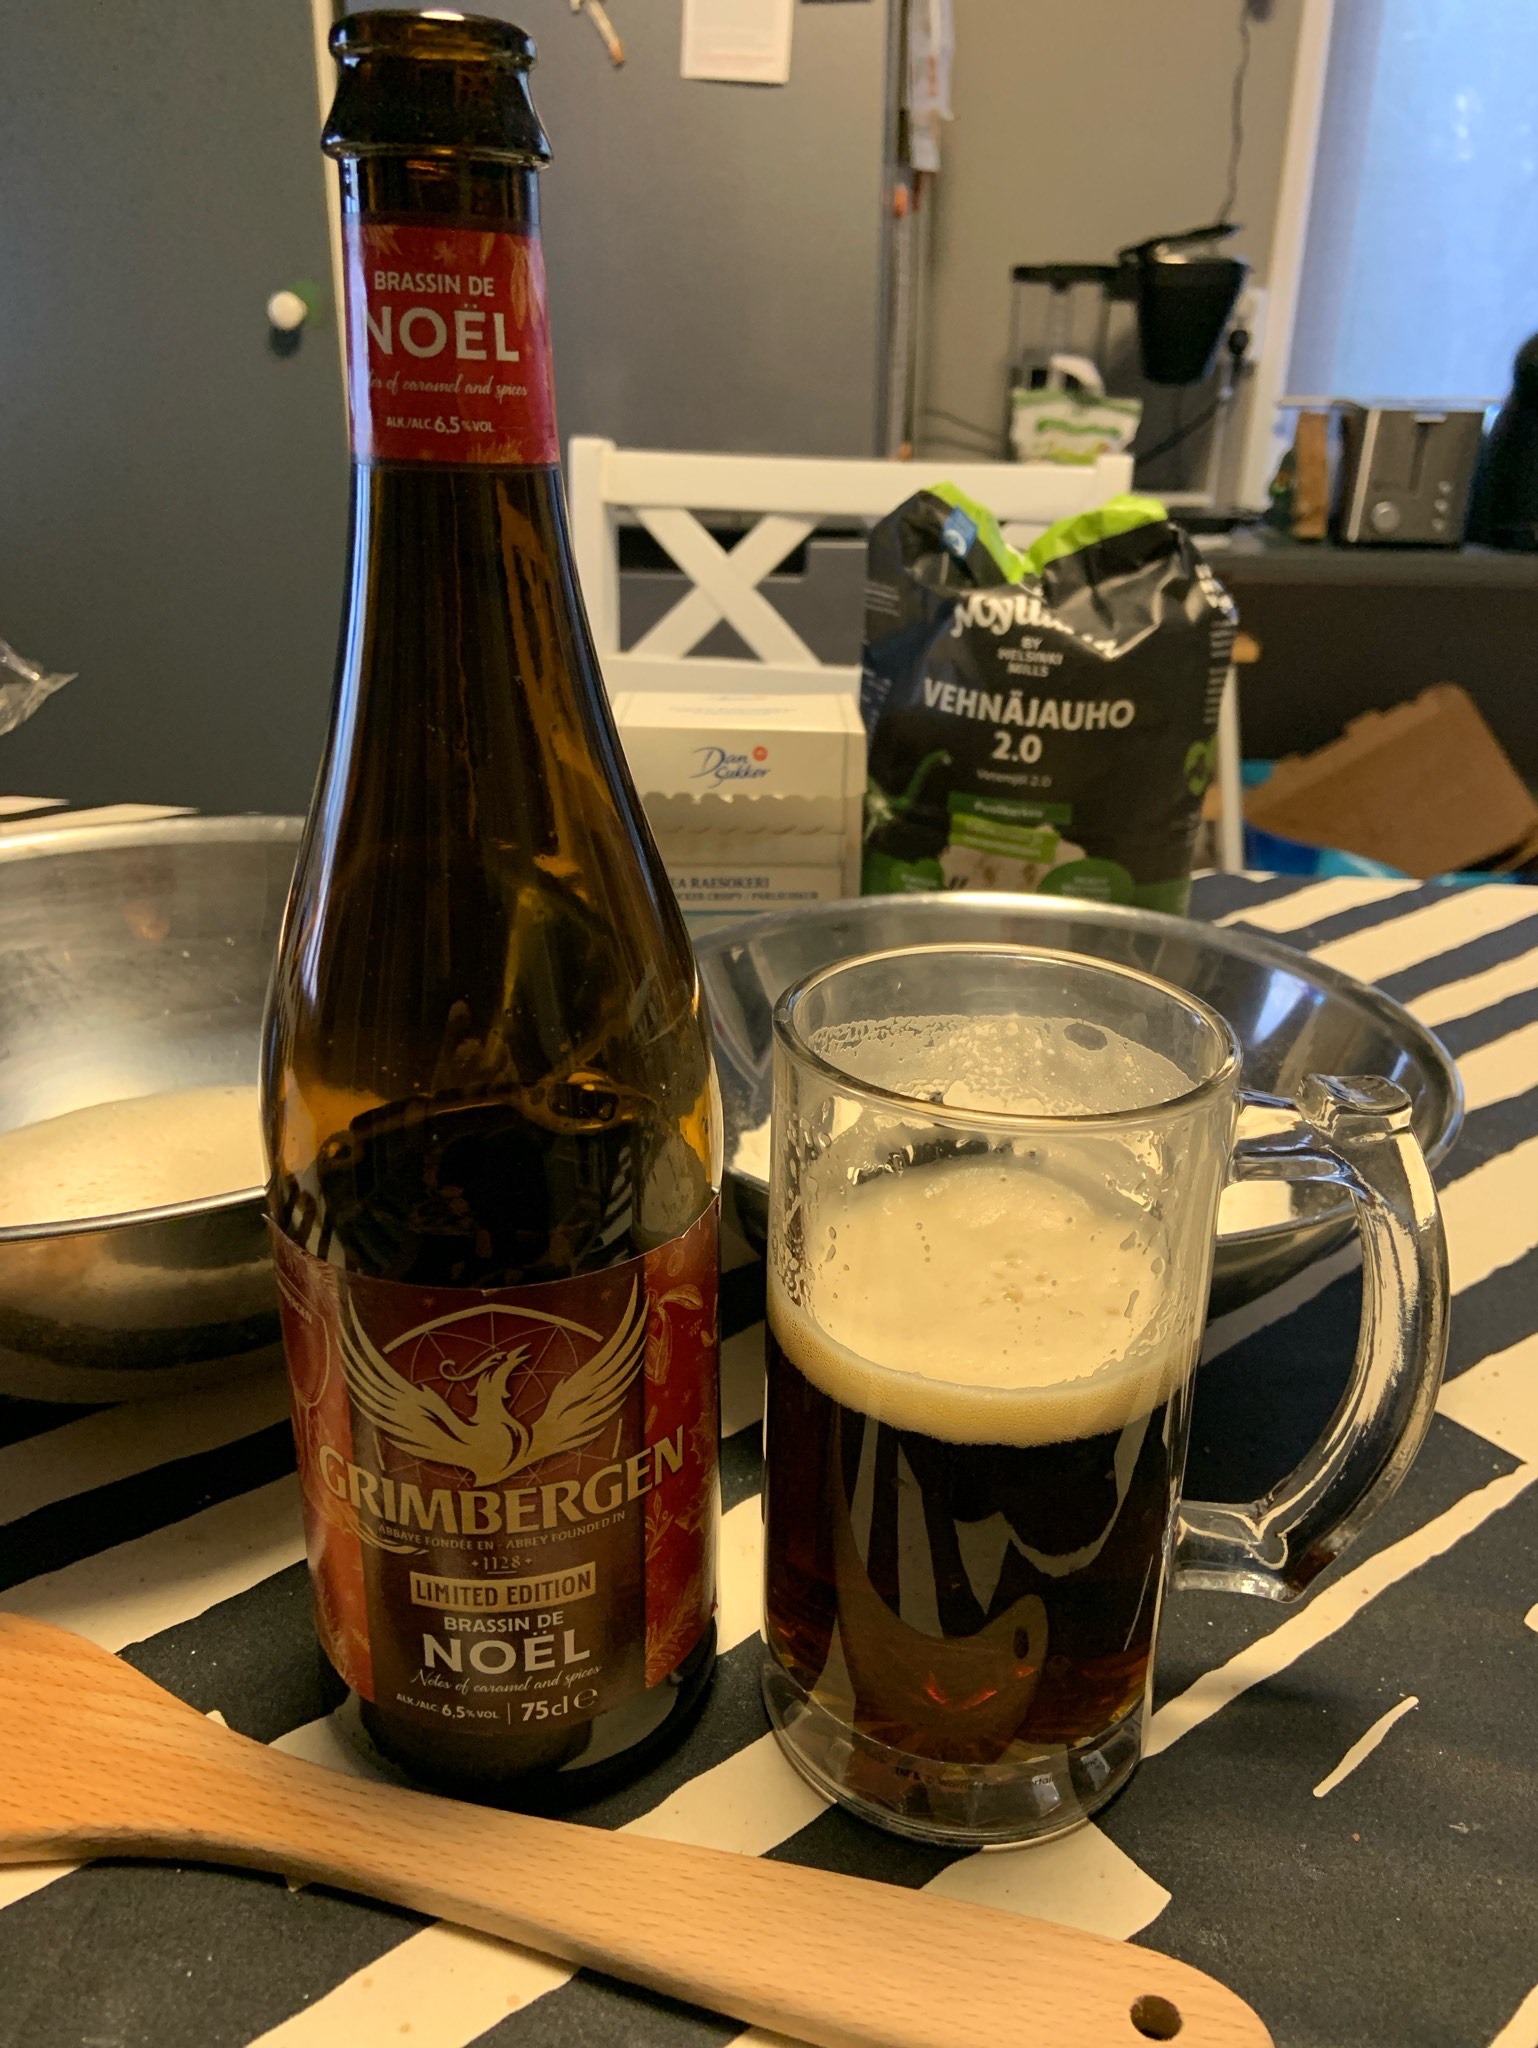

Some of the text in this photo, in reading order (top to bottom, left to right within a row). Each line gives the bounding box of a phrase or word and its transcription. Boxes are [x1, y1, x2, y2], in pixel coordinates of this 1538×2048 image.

[374, 270, 495, 297] BRASSIN DE
[464, 375, 494, 395] and
[495, 384, 528, 405] spices
[1020, 636, 1043, 650] BY
[1006, 663, 1050, 678] MILLS
[923, 677, 1136, 731] VEHNÄJAUHO
[689, 746, 748, 778] Dan
[992, 730, 1043, 764] 2.0
[319, 1425, 684, 1535] GRIMBERGEN
[378, 1523, 422, 1545] ABBAYE
[477, 1541, 494, 1550] EN
[506, 1535, 548, 1550] ABBEY
[551, 1517, 610, 1543] FOUNDED
[612, 1511, 626, 1524] IN
[483, 1556, 521, 1571] 1128
[416, 1570, 591, 1607] LIMITED EDITION
[444, 1610, 564, 1633] BRASSIN DE
[423, 1628, 591, 1675] NOËL
[410, 1664, 603, 1695] Notes of caramel and spices
